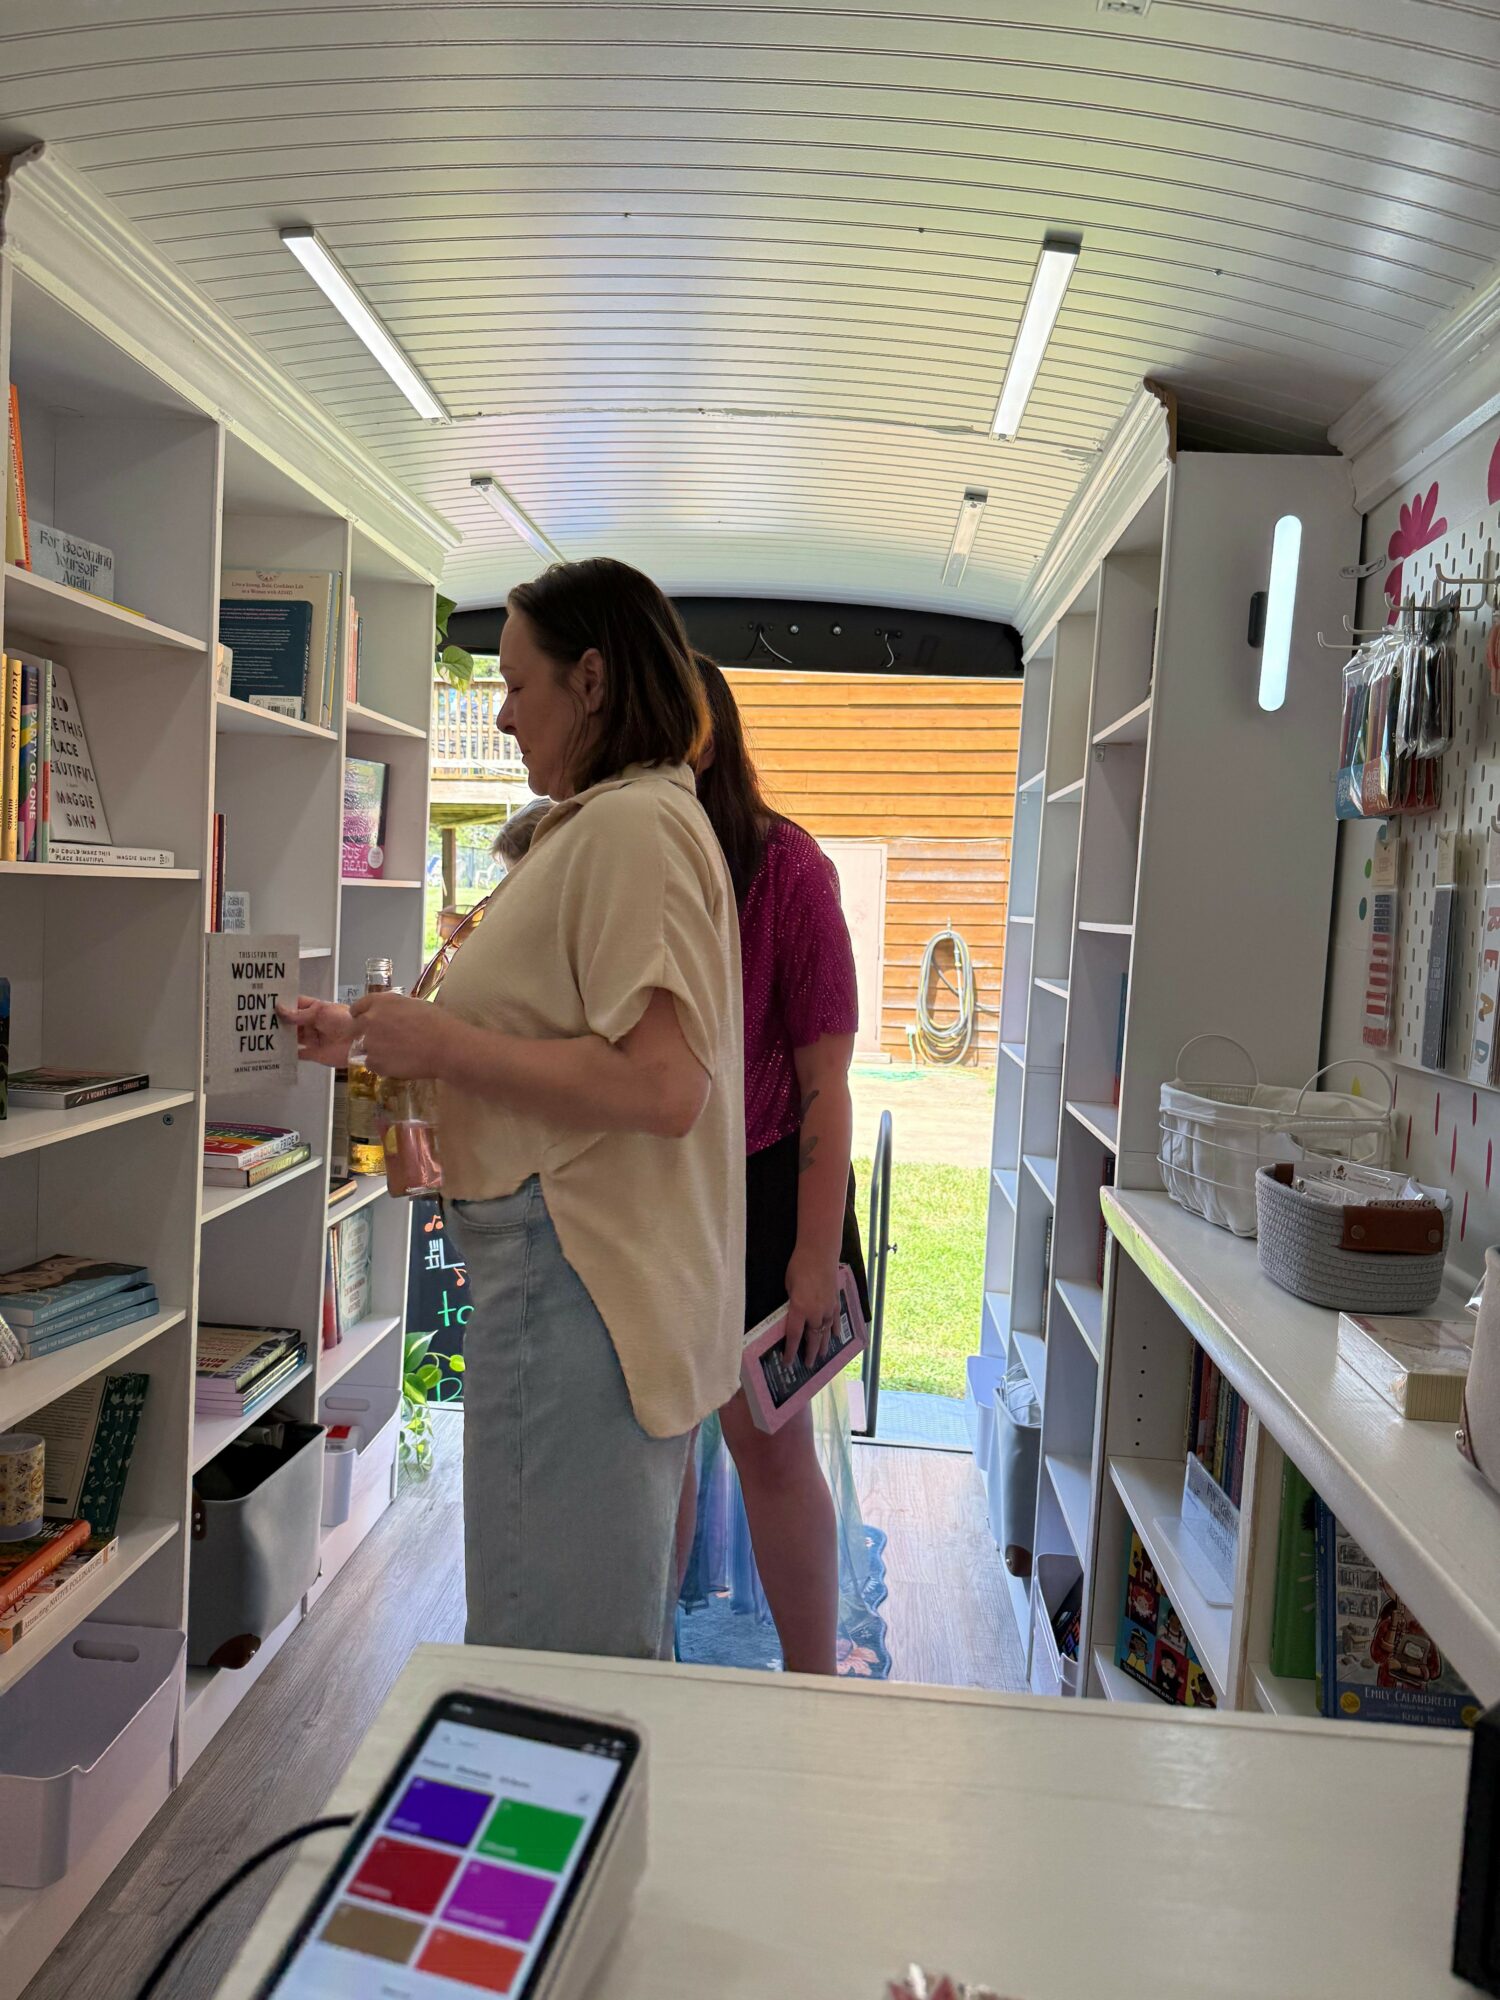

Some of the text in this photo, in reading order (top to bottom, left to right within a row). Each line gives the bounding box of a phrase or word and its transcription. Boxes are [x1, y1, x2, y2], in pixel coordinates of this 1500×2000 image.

[40, 530, 112, 570] For Becoming
[56, 552, 98, 578] Yourself
[62, 570, 92, 592] Again
[51, 696, 68, 712] ULD
[30, 708, 39, 757] PARTY
[62, 720, 83, 738] THIS
[29, 761, 36, 783] OF
[50, 760, 94, 782] EAUTIFUL
[56, 790, 95, 810] MAGGIE
[66, 812, 96, 830] SMITH
[344, 860, 368, 872] READ
[232, 962, 285, 980] WOMEN
[237, 993, 278, 1011] DON'T
[235, 1014, 279, 1032] GIVE A
[240, 1034, 274, 1052] FUCK
[8, 1565, 45, 1602] WILDFLOWERS
[1365, 1687, 1390, 1700] EMILY
[1395, 1690, 1456, 1707] CALANDRELLI
